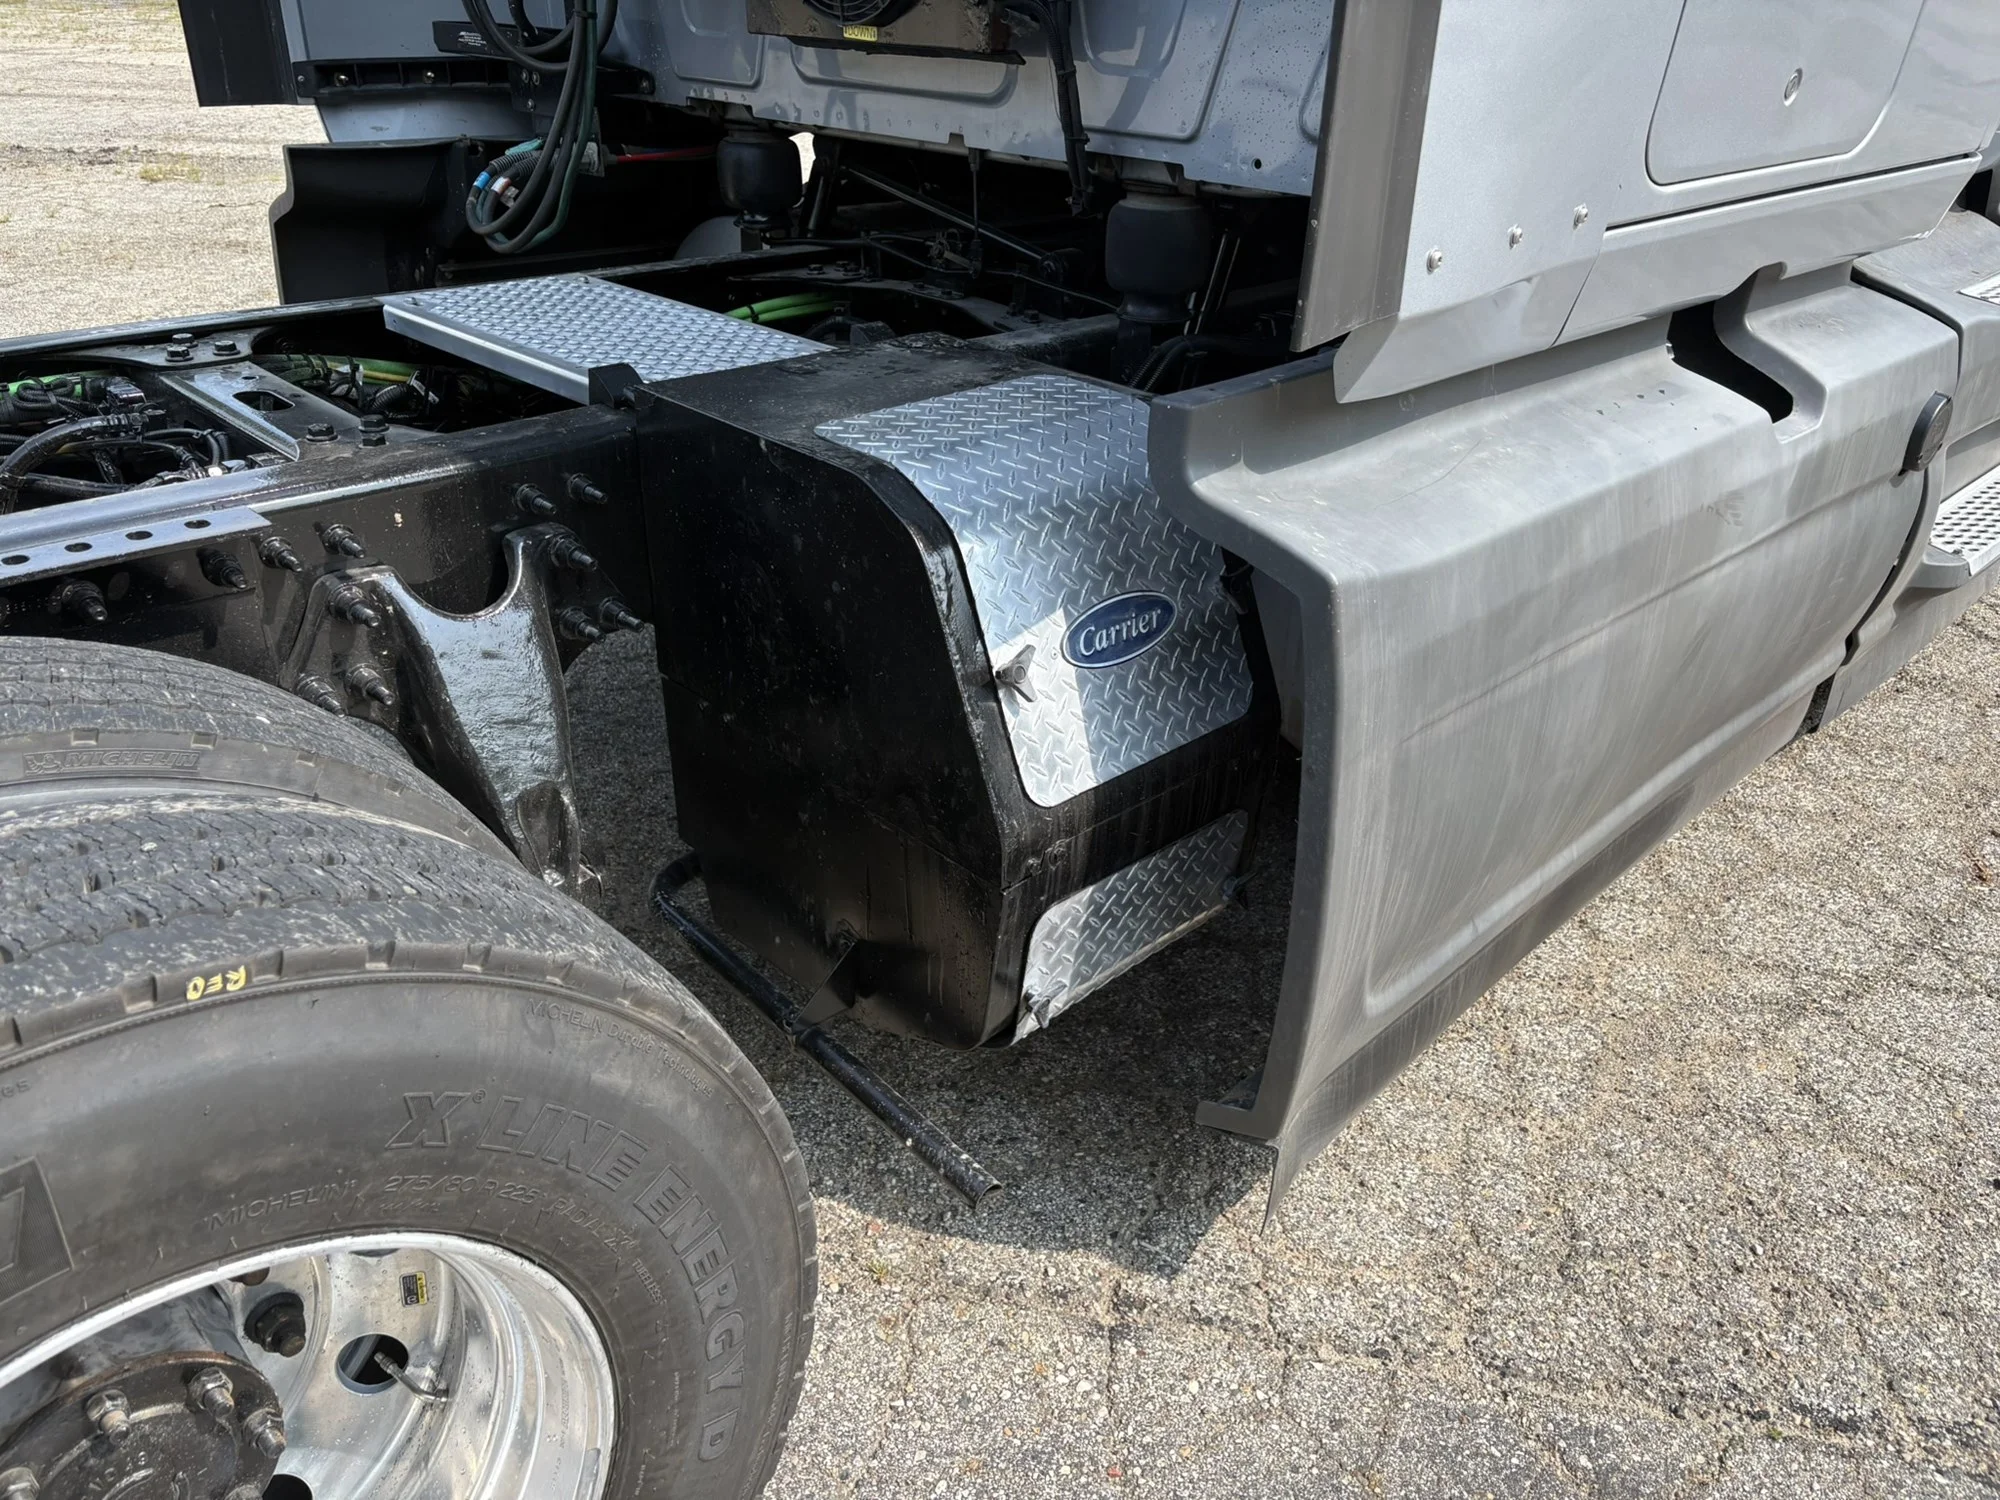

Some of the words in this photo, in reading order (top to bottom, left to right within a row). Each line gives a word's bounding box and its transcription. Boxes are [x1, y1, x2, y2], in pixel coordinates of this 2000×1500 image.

[847, 25, 874, 38] DOWN
[1080, 608, 1162, 656] Carrier
[64, 751, 200, 767] MICHELIN
[384, 1175, 478, 1194] 275/80
[476, 1095, 649, 1192] LINE
[633, 1163, 747, 1395] ENERGY
[698, 1407, 741, 1462] D
